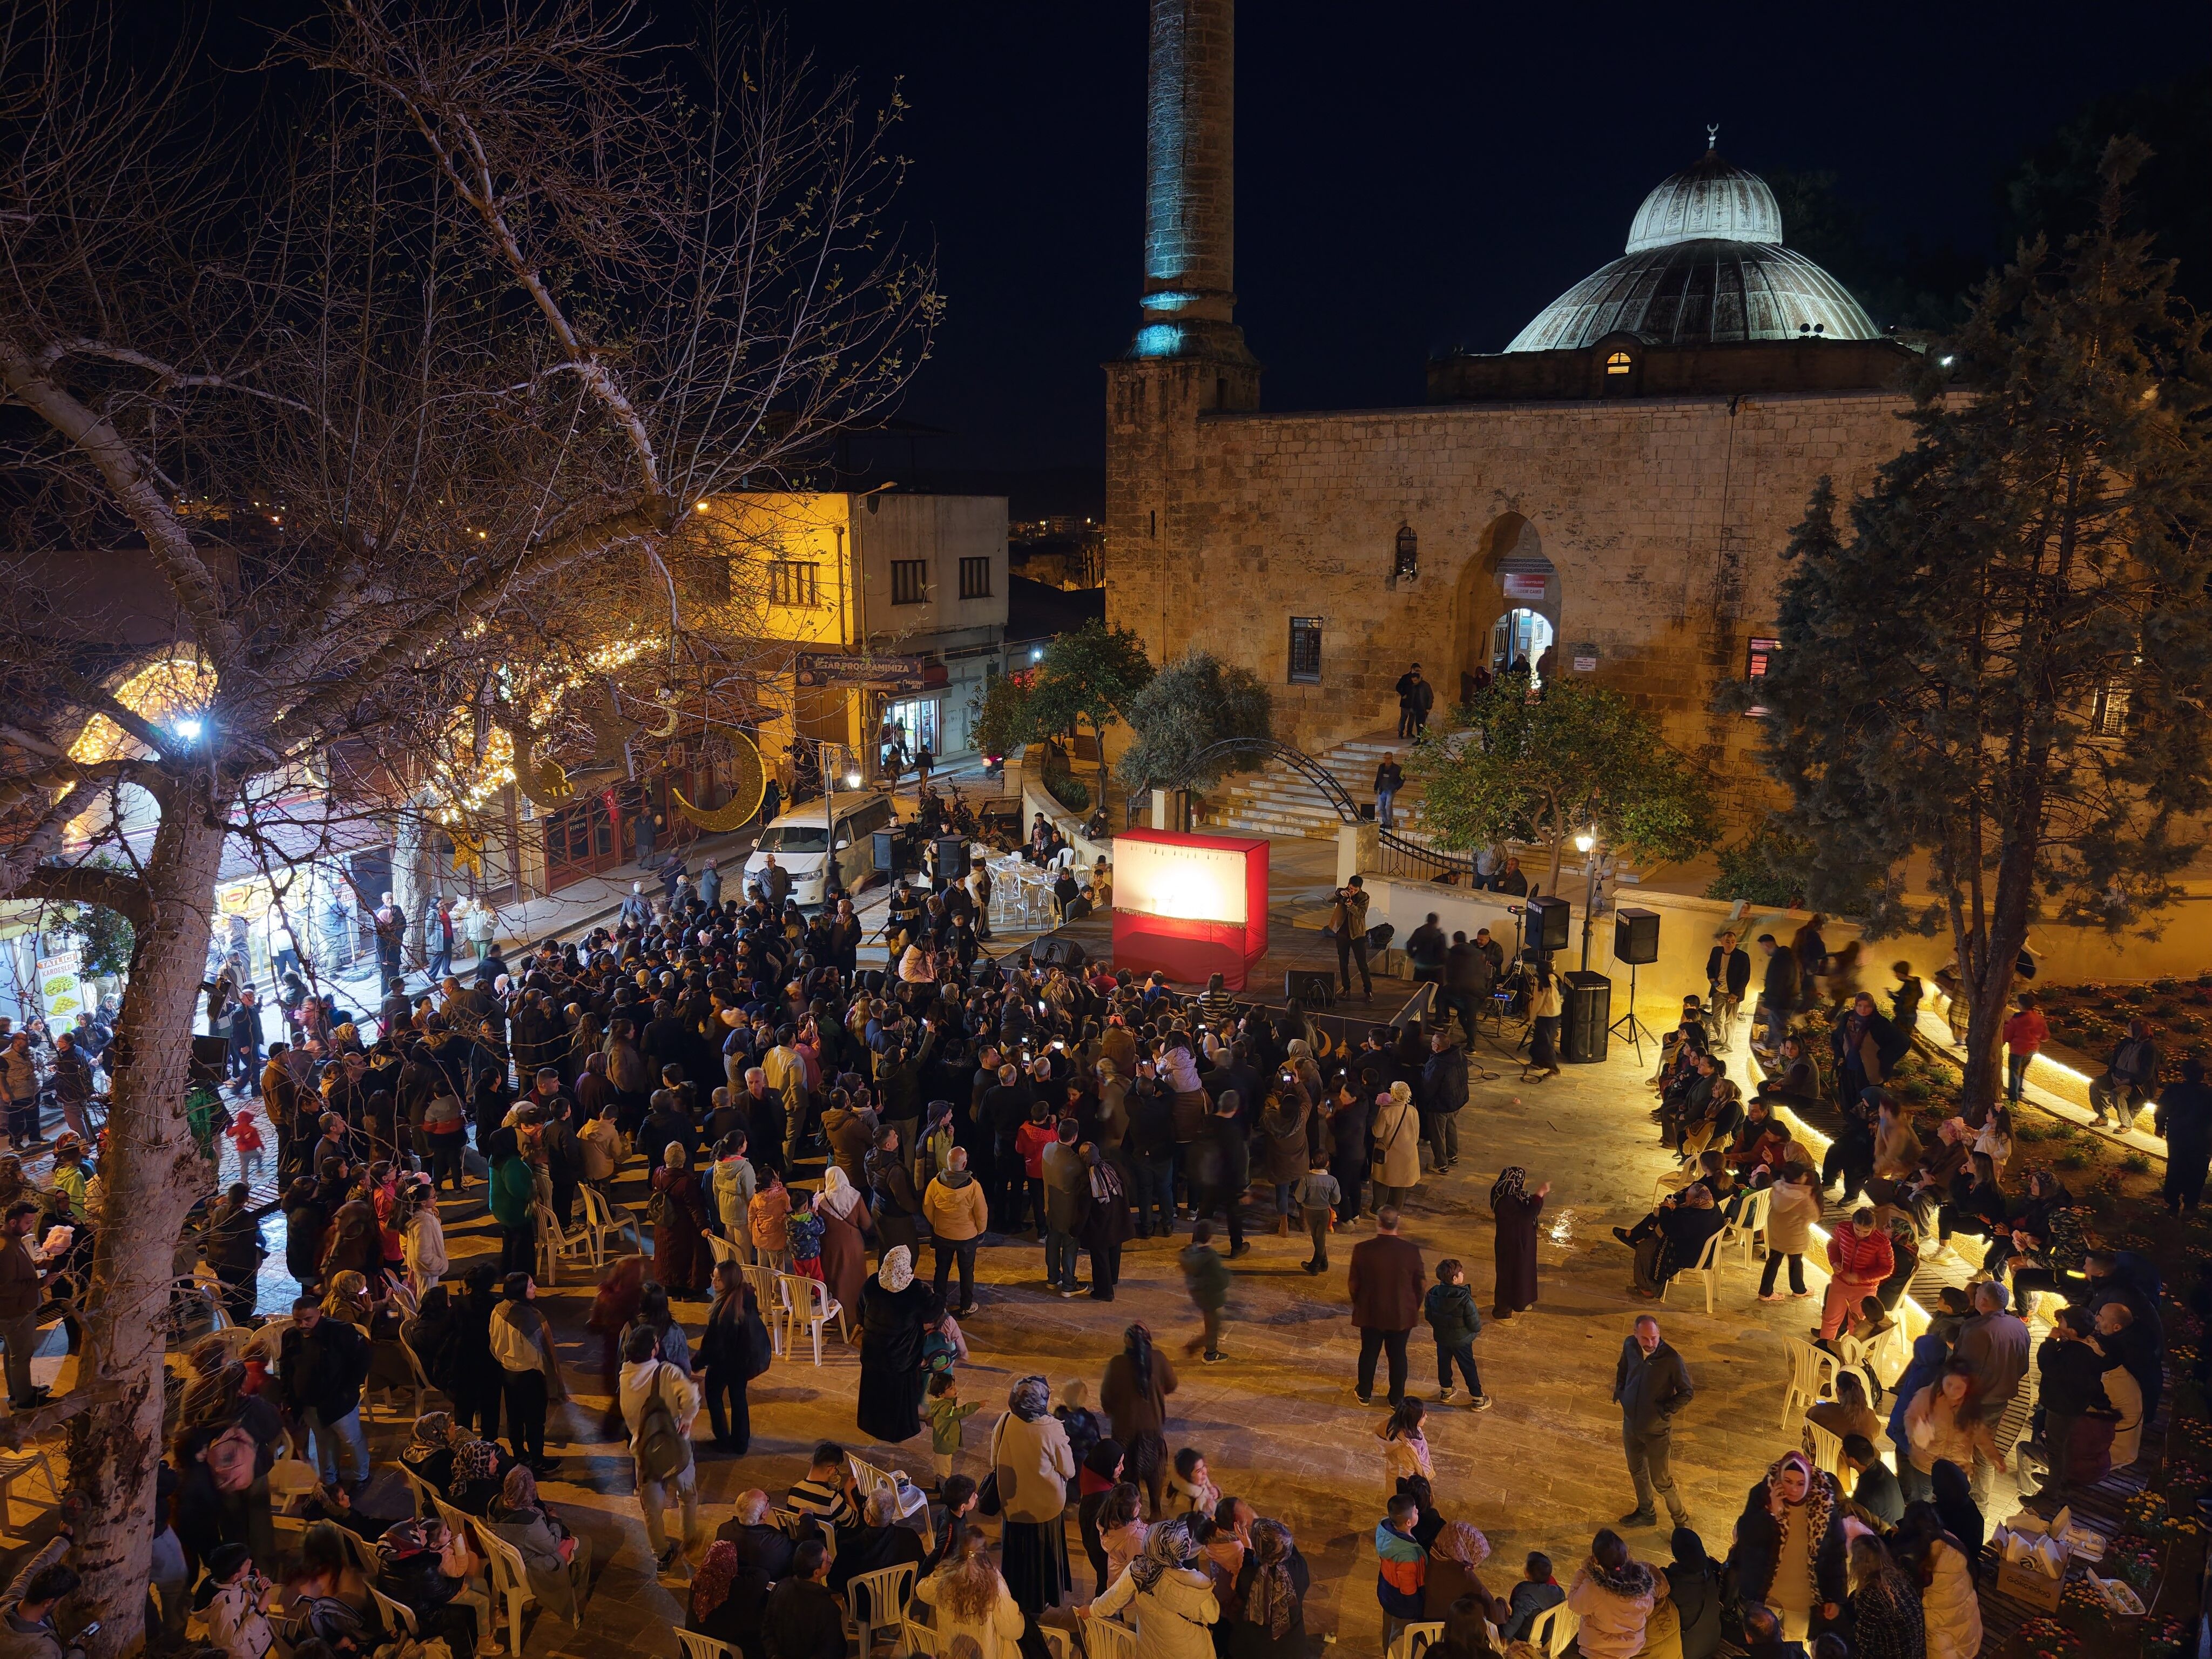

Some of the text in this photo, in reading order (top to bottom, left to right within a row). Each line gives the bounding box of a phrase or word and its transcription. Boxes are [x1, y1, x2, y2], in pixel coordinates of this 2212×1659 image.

[570, 821, 586, 832] FIRIN
[227, 894, 242, 902] Lipton
[39, 954, 75, 969] TATLICI
